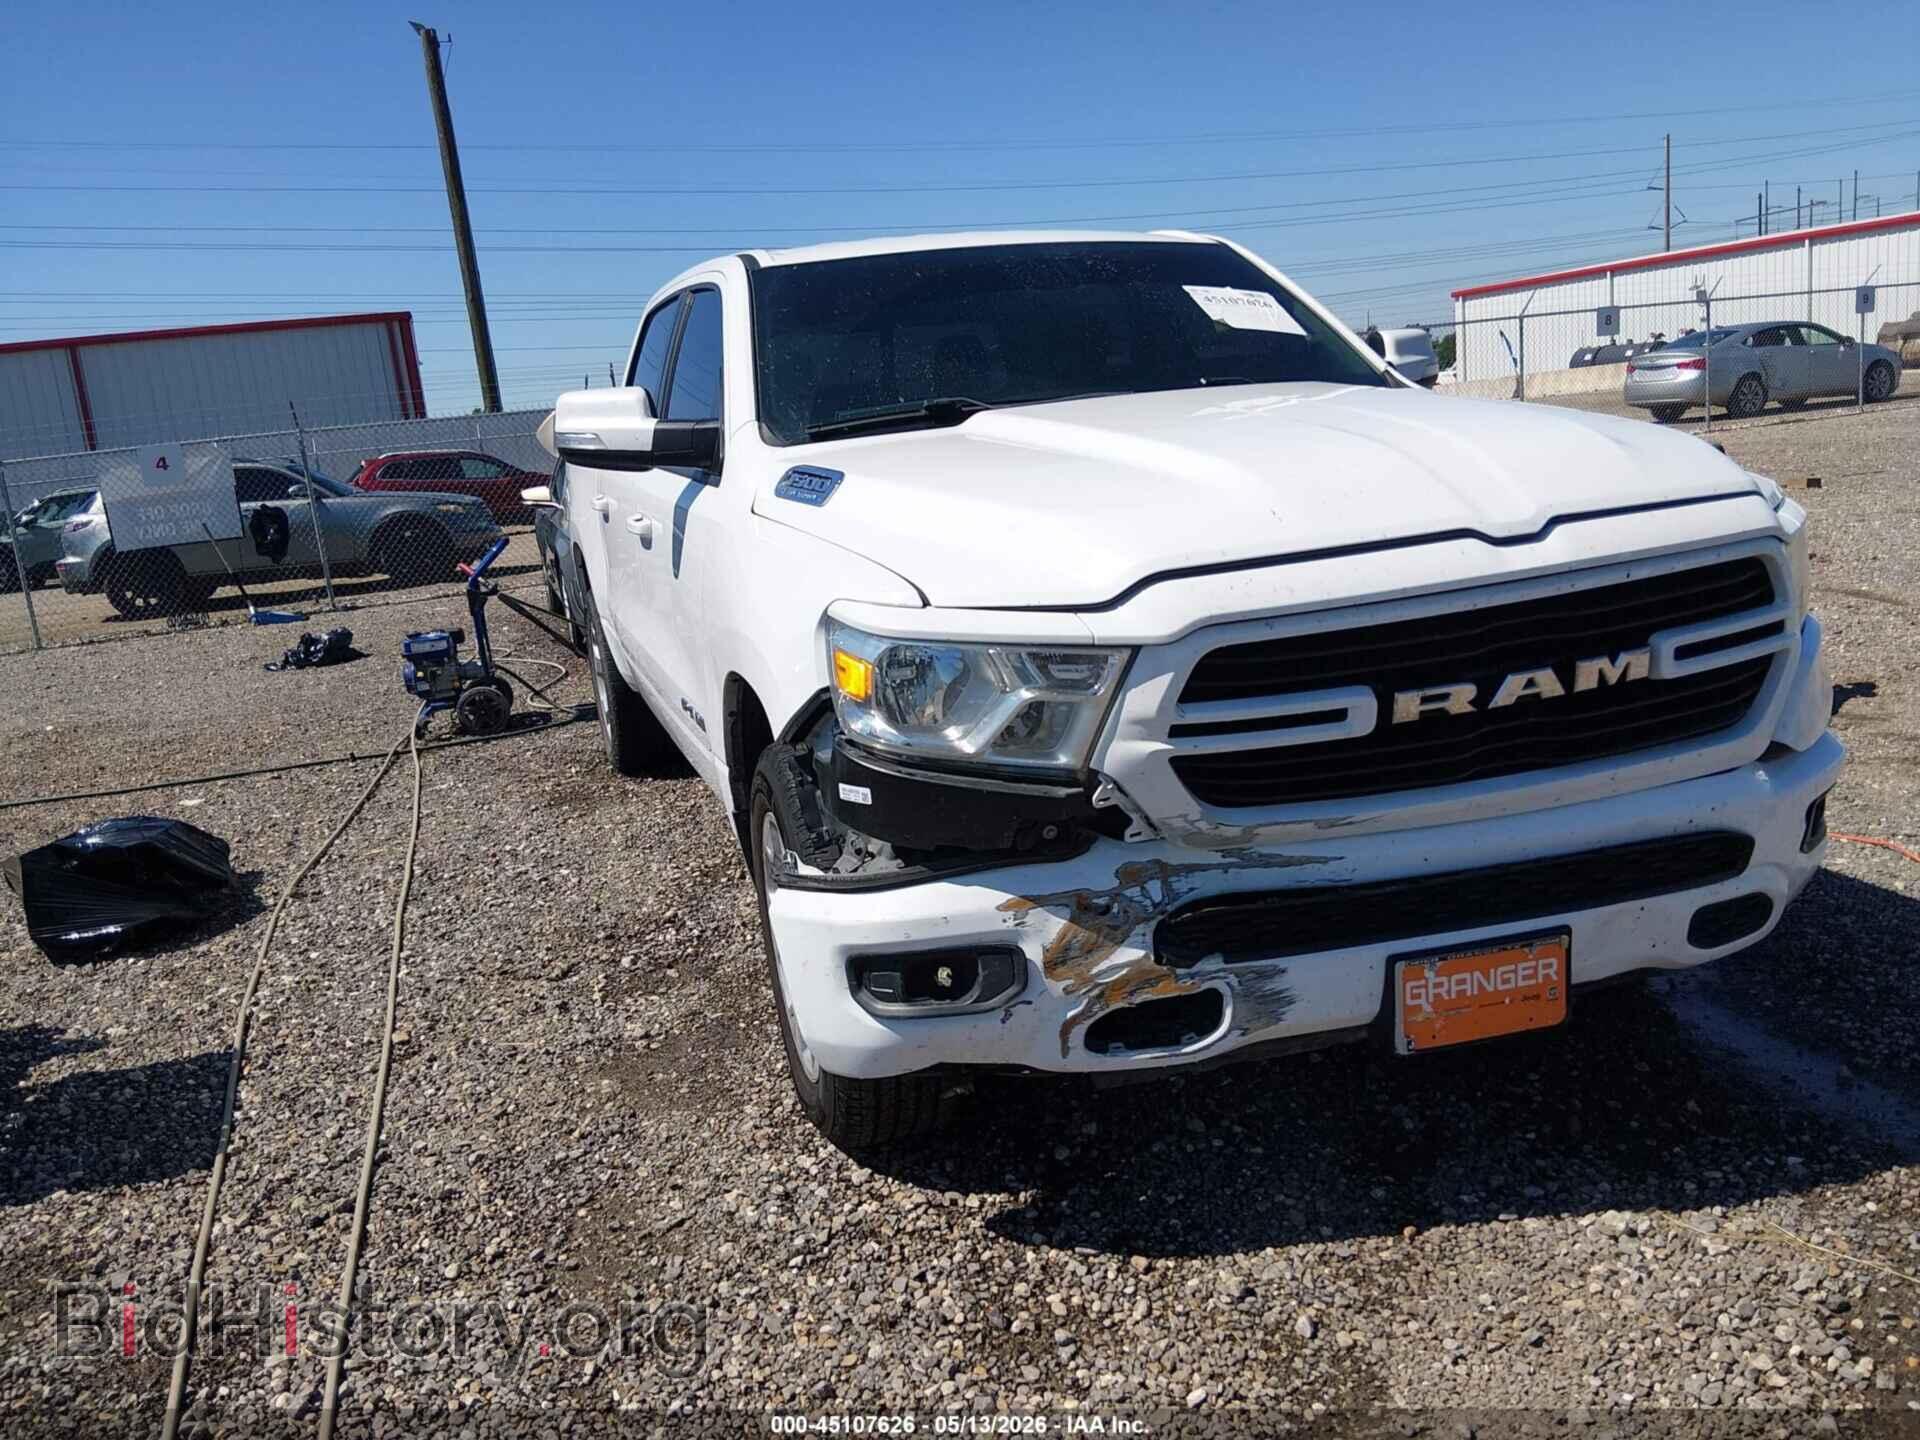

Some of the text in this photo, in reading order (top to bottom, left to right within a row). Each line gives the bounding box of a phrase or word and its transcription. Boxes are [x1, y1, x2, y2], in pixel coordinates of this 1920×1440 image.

[1605, 314, 1613, 326] 8
[155, 456, 170, 471] 4
[1392, 647, 1652, 725] RAM
[1405, 957, 1559, 1007] GRANGER
